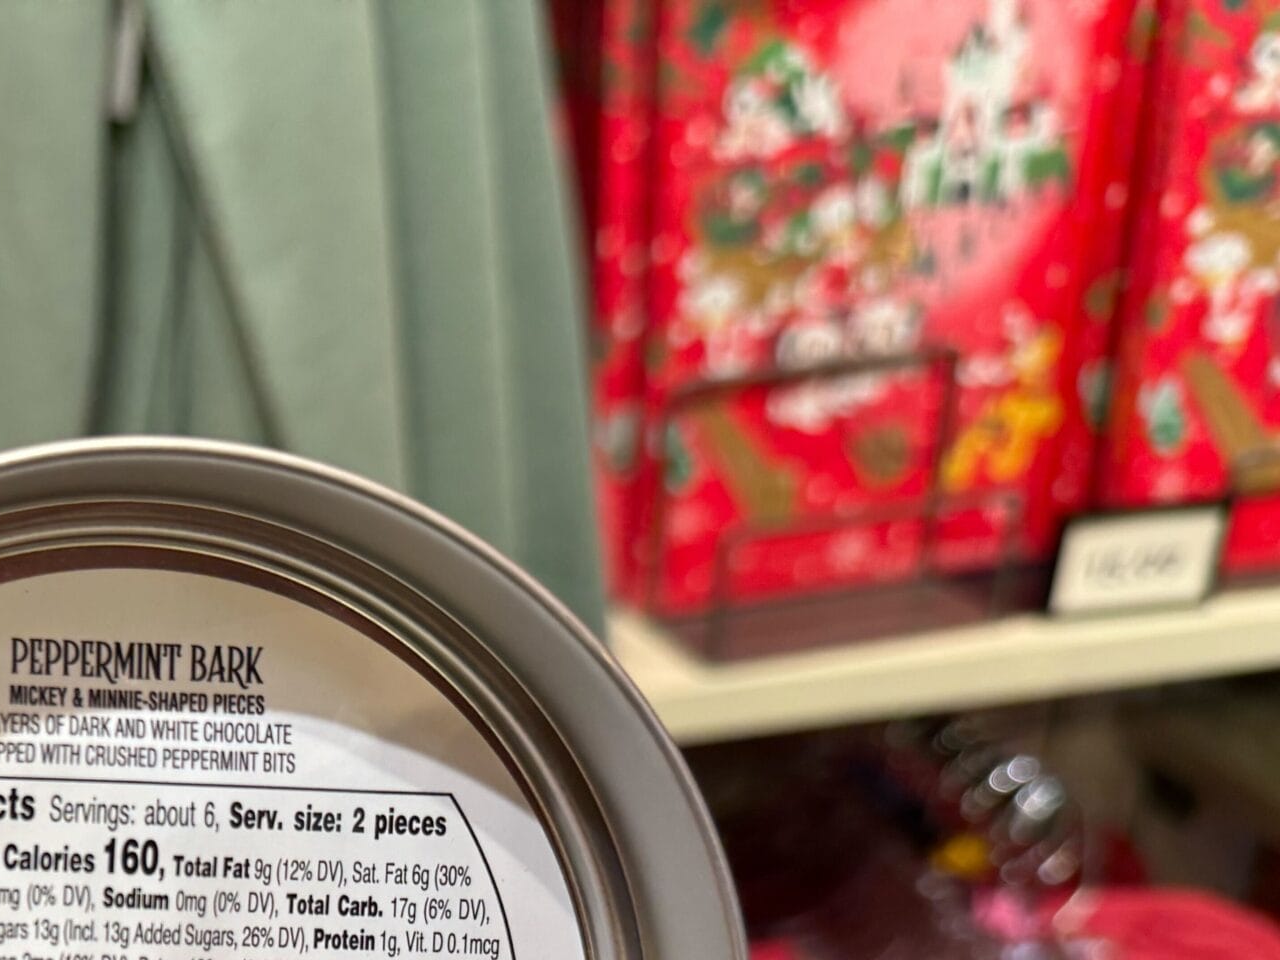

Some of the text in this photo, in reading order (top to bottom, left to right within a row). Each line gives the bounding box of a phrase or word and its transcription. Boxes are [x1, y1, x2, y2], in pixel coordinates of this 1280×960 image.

[11, 637, 263, 689] PEPPERMINT BARK
[10, 685, 265, 715] MICKEY & MINNIE-SHAPED PIECES
[45, 714, 66, 736] OF
[68, 715, 111, 737] DARK
[115, 717, 146, 739] AND
[150, 719, 199, 741] WHITE
[203, 721, 292, 745] CHOCOLATE
[40, 743, 81, 765] WITH
[85, 744, 158, 768] CRUSHED
[162, 748, 259, 772] PEPPERMINT
[263, 751, 295, 774] BITS
[49, 794, 135, 833] Servings:
[144, 798, 196, 828] about
[204, 801, 220, 832] 6,
[230, 801, 282, 831] Serv.
[294, 803, 341, 833] size:
[352, 807, 365, 834] 2
[375, 806, 446, 843] pieces
[3, 842, 96, 873] Calories
[101, 838, 166, 881] 160,
[173, 854, 218, 878] Total
[223, 856, 250, 879] Fat
[277, 858, 313, 886] (12%
[317, 859, 347, 888] DV),
[352, 861, 379, 884] Sat.
[385, 862, 408, 885] Fat
[435, 864, 471, 892] (30%
[103, 885, 169, 911] Sodium
[286, 893, 330, 916] Total
[338, 894, 383, 918] Carb.
[391, 897, 416, 925] 17g
[424, 897, 452, 925] (6%
[459, 898, 489, 927] DV),
[133, 923, 182, 946] Added
[185, 925, 237, 953] Sugars,
[242, 927, 274, 948] 26%
[278, 928, 308, 954] DV),
[314, 929, 375, 952] Protein
[380, 932, 400, 958] 1g,
[406, 933, 427, 953] Vit.
[447, 934, 500, 960] 0.1mcg
